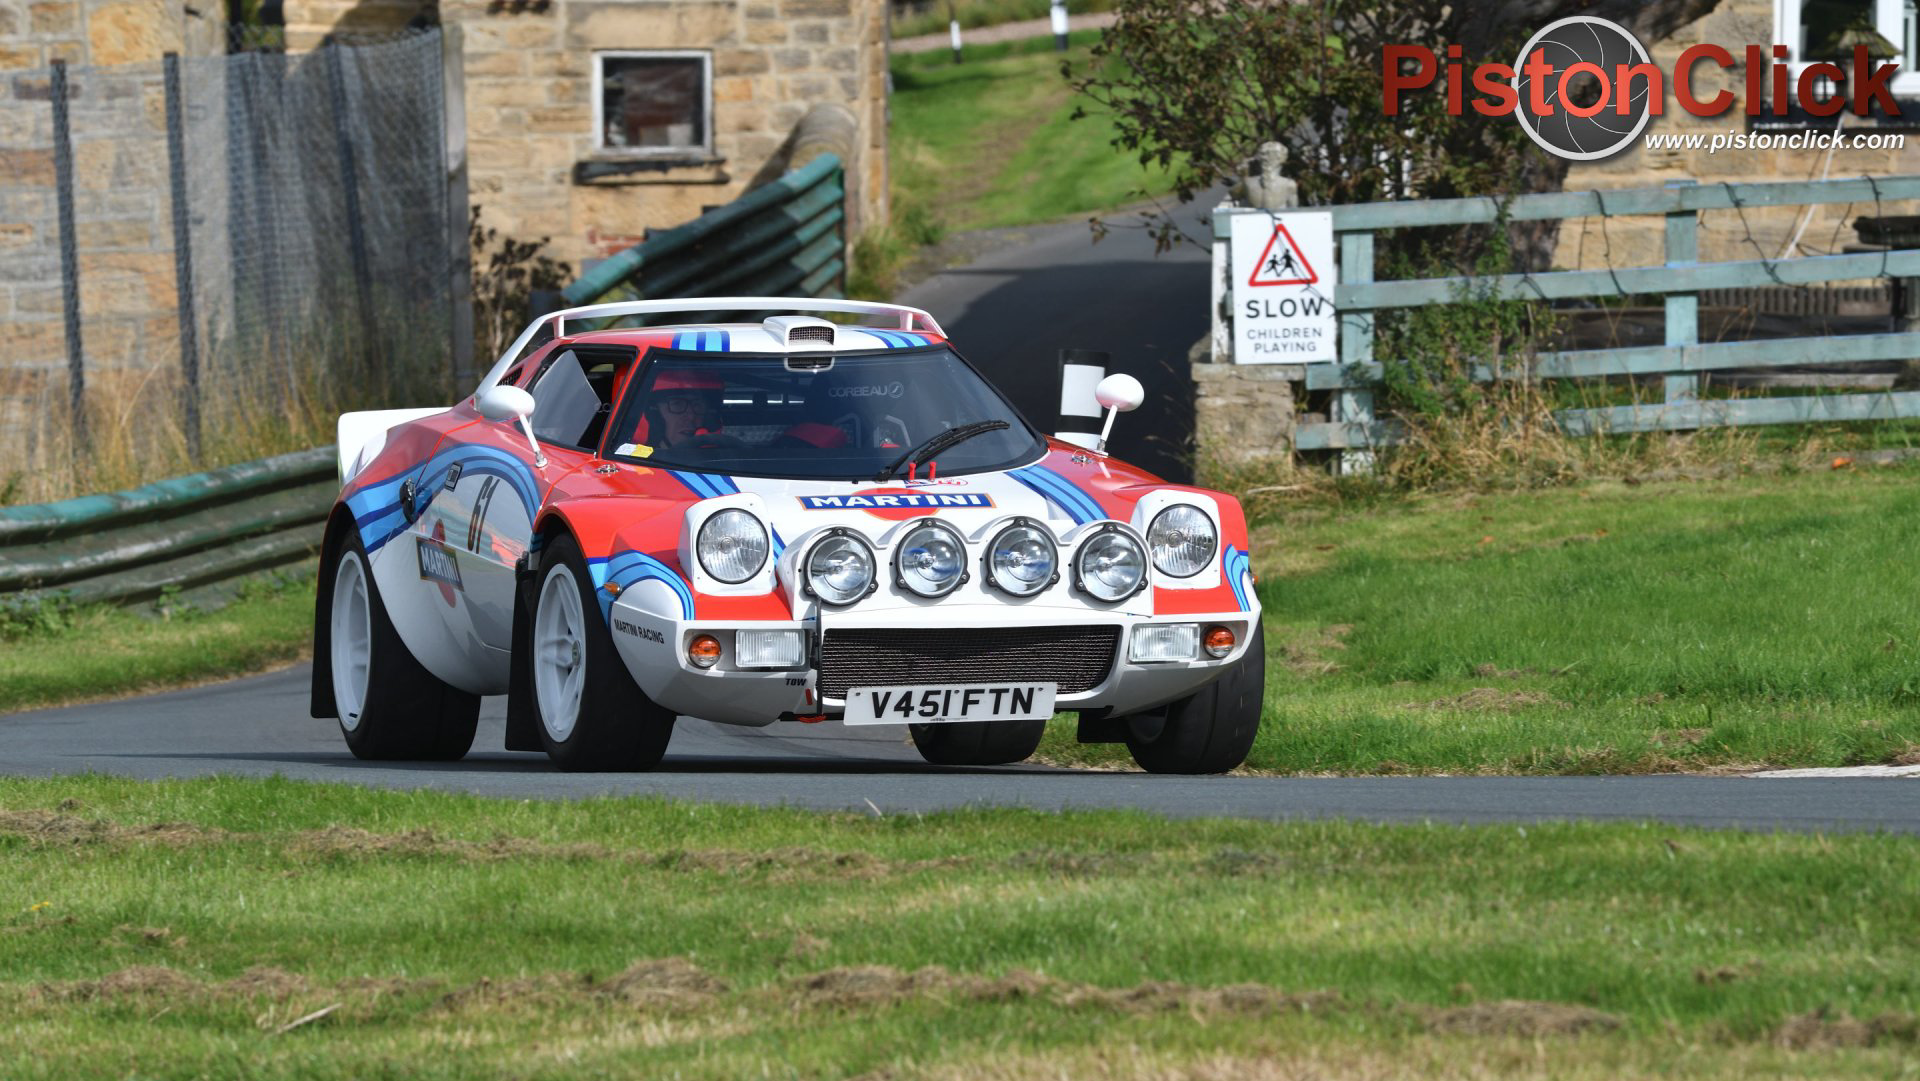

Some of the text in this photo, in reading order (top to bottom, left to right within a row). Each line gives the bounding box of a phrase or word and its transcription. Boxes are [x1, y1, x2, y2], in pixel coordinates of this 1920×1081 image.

[1246, 297, 1324, 318] SLOW
[1247, 327, 1322, 340] CHILDREN
[1254, 341, 1317, 353] PLAYING
[828, 385, 888, 398] CORBEAU
[810, 494, 983, 507] MARTINI
[420, 546, 460, 582] MARTINI
[614, 619, 664, 644] MARTINI RACING
[785, 678, 807, 686] TOW
